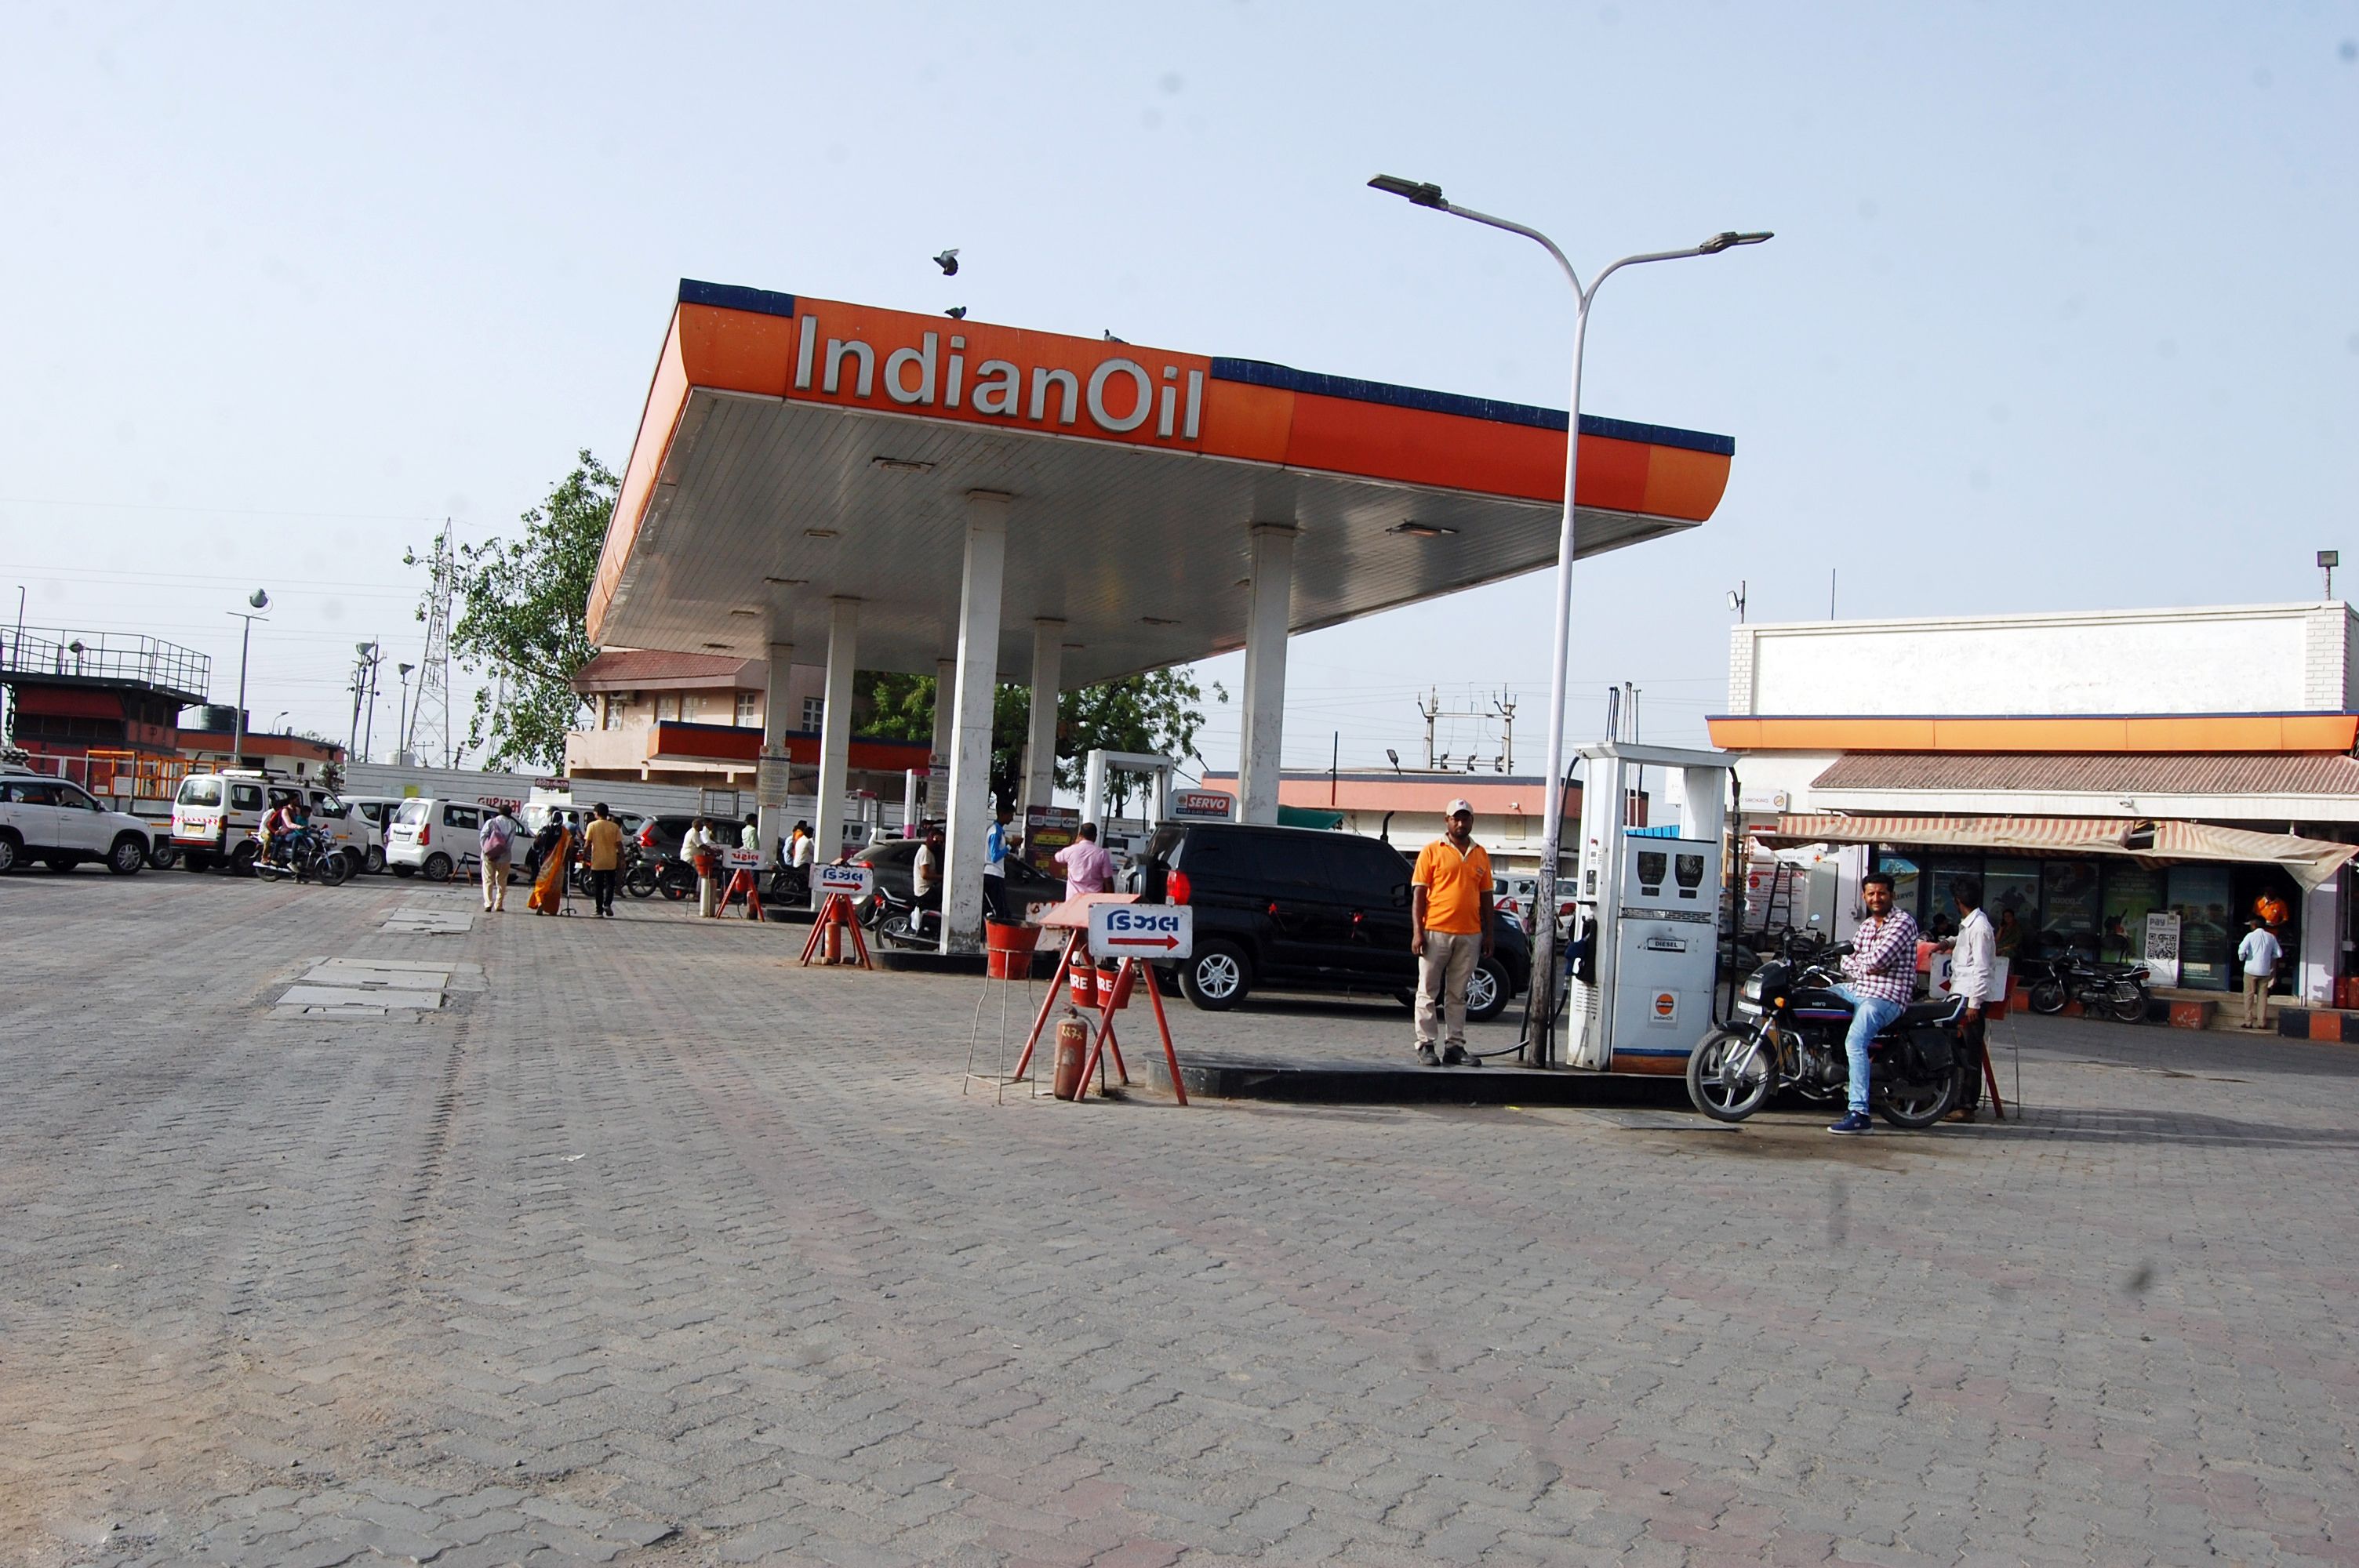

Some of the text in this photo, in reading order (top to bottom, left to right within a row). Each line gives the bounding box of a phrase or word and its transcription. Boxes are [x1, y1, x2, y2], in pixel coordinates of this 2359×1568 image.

[794, 315, 1204, 441] IndianOil
[1188, 797, 1227, 809] SERVO
[823, 868, 863, 882] ડિઝલ
[1107, 909, 1179, 931] ડિઝલ
